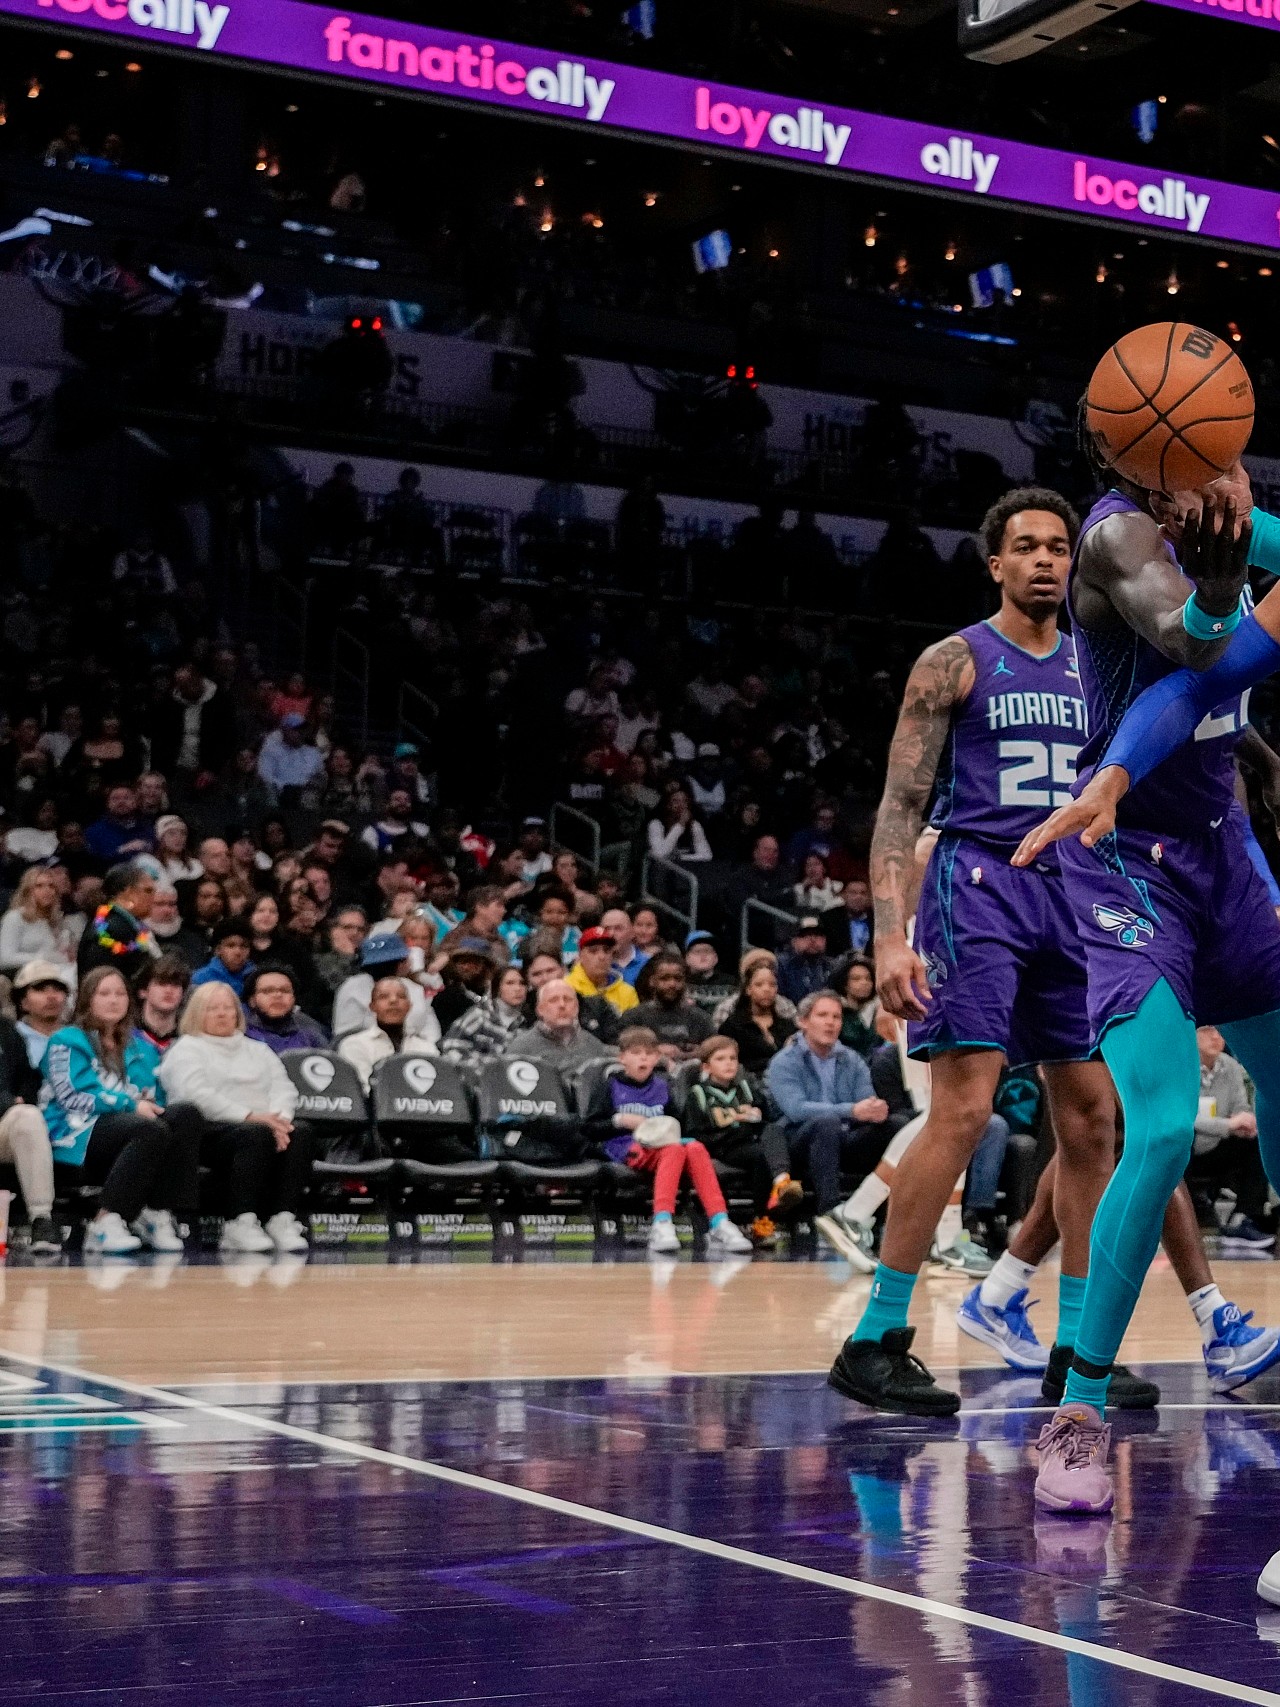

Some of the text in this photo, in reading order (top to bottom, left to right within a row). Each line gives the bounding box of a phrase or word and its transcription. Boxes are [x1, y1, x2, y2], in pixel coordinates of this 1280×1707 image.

[37, 0, 230, 50] cally
[324, 17, 616, 121] fanatically
[695, 87, 852, 165] loyally
[920, 137, 1000, 193] ally
[1073, 160, 1211, 232] locally
[985, 692, 1085, 731] HORNET
[999, 740, 1083, 807] 25
